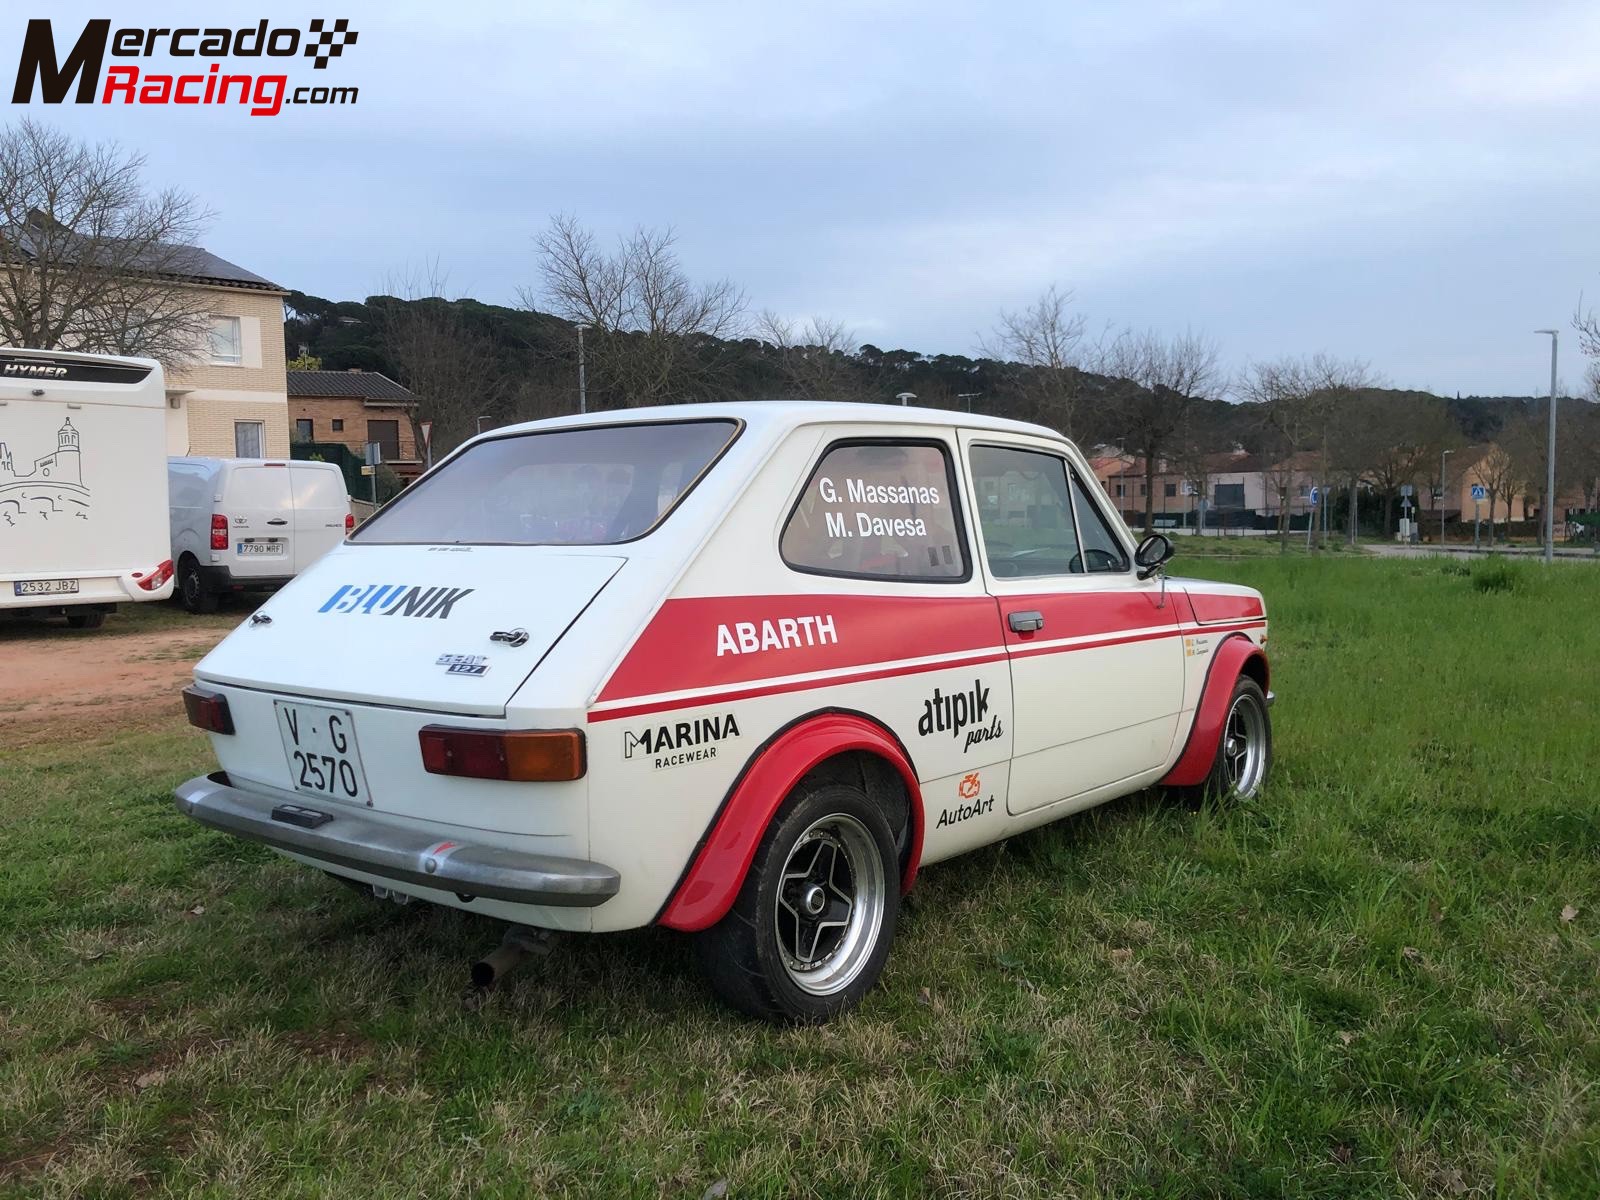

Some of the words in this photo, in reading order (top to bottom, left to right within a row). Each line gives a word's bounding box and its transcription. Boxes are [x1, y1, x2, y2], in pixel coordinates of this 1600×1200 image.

[4, 363, 68, 378] HYMER
[819, 477, 842, 503] G.
[846, 478, 940, 504] Massanas
[825, 512, 853, 537] M.
[856, 512, 927, 537] Davesa
[243, 544, 264, 553] 7790
[266, 544, 281, 553] MRF
[22, 581, 52, 592] 2532
[55, 580, 76, 591] JBZ
[716, 614, 839, 657] ABARTH
[436, 653, 488, 666] SEAT
[452, 664, 484, 675] 127
[283, 707, 299, 746] V
[328, 714, 347, 754] G
[624, 713, 740, 759] MARINA
[963, 714, 1004, 754] parts
[655, 747, 717, 769] RACEWEAR
[293, 750, 358, 798] 2570
[936, 794, 995, 829] AutoArt
